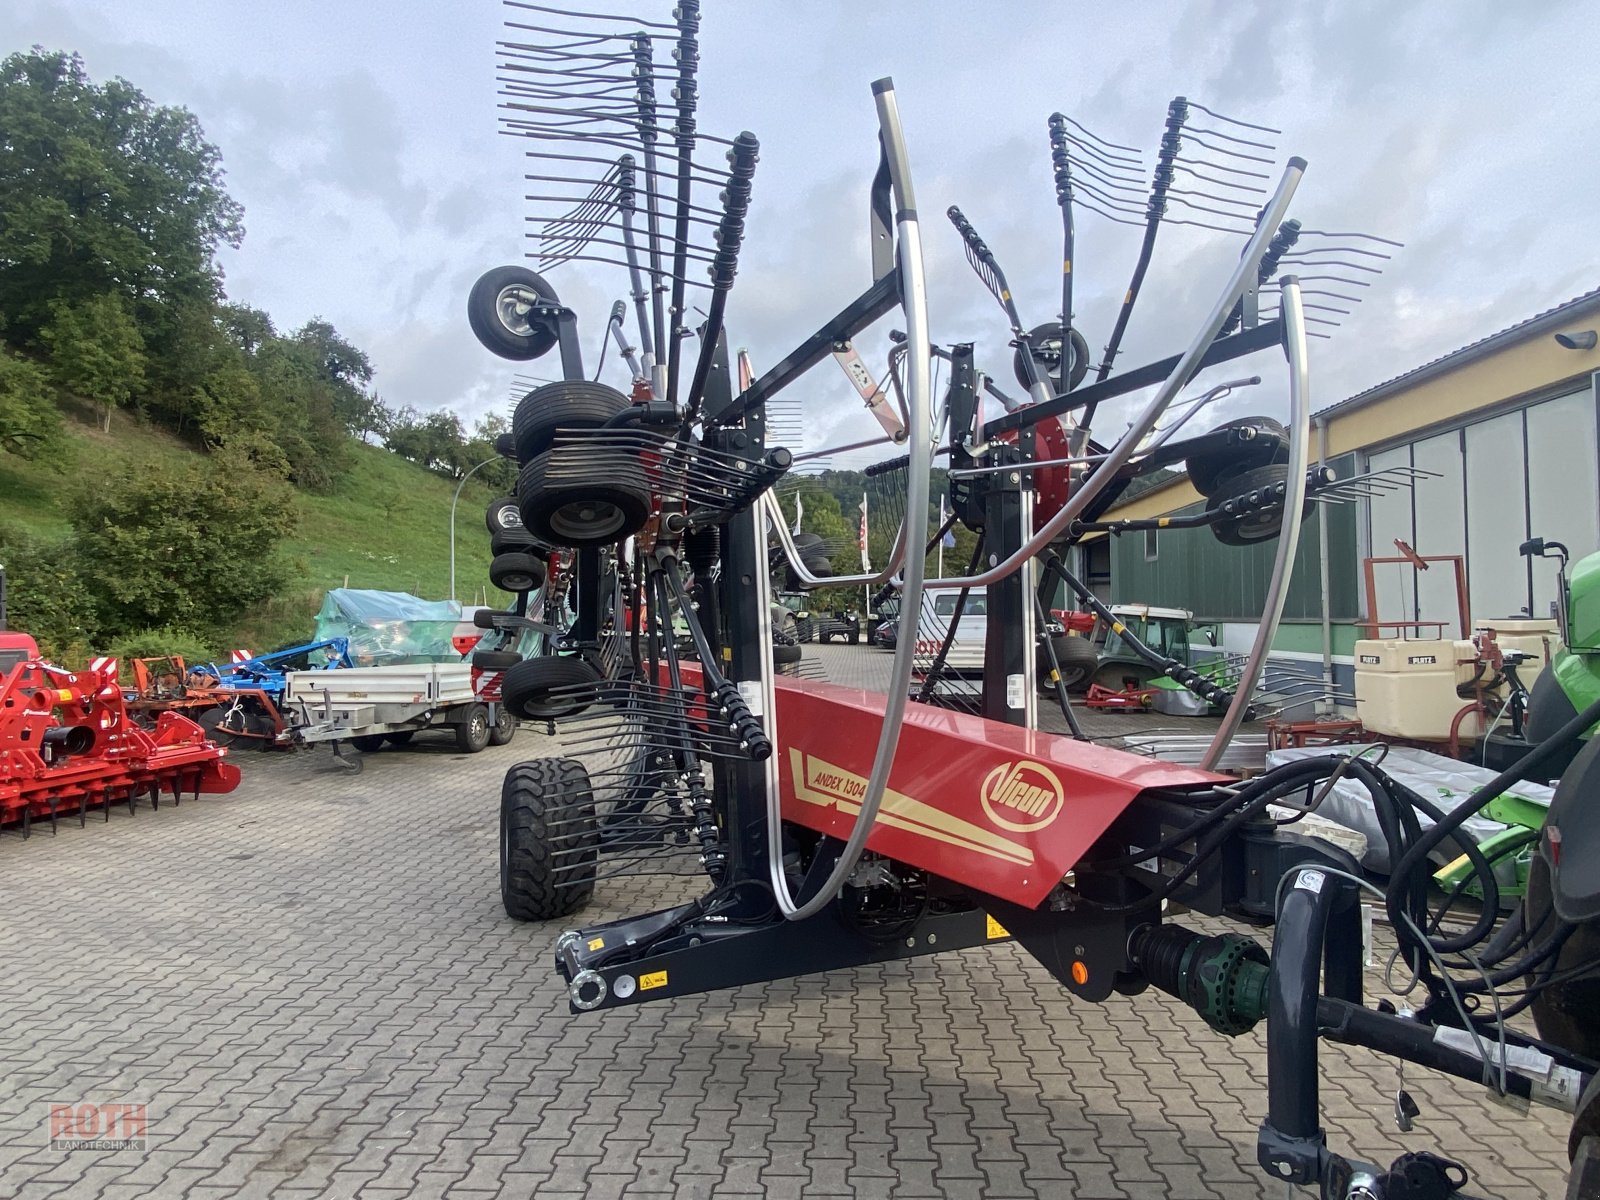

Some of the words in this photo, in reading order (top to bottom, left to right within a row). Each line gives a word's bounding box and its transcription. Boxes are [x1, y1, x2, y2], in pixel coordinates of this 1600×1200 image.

[814, 772, 843, 791] ANDEX
[843, 779, 867, 798] 1304
[989, 761, 1056, 818] Vicon
